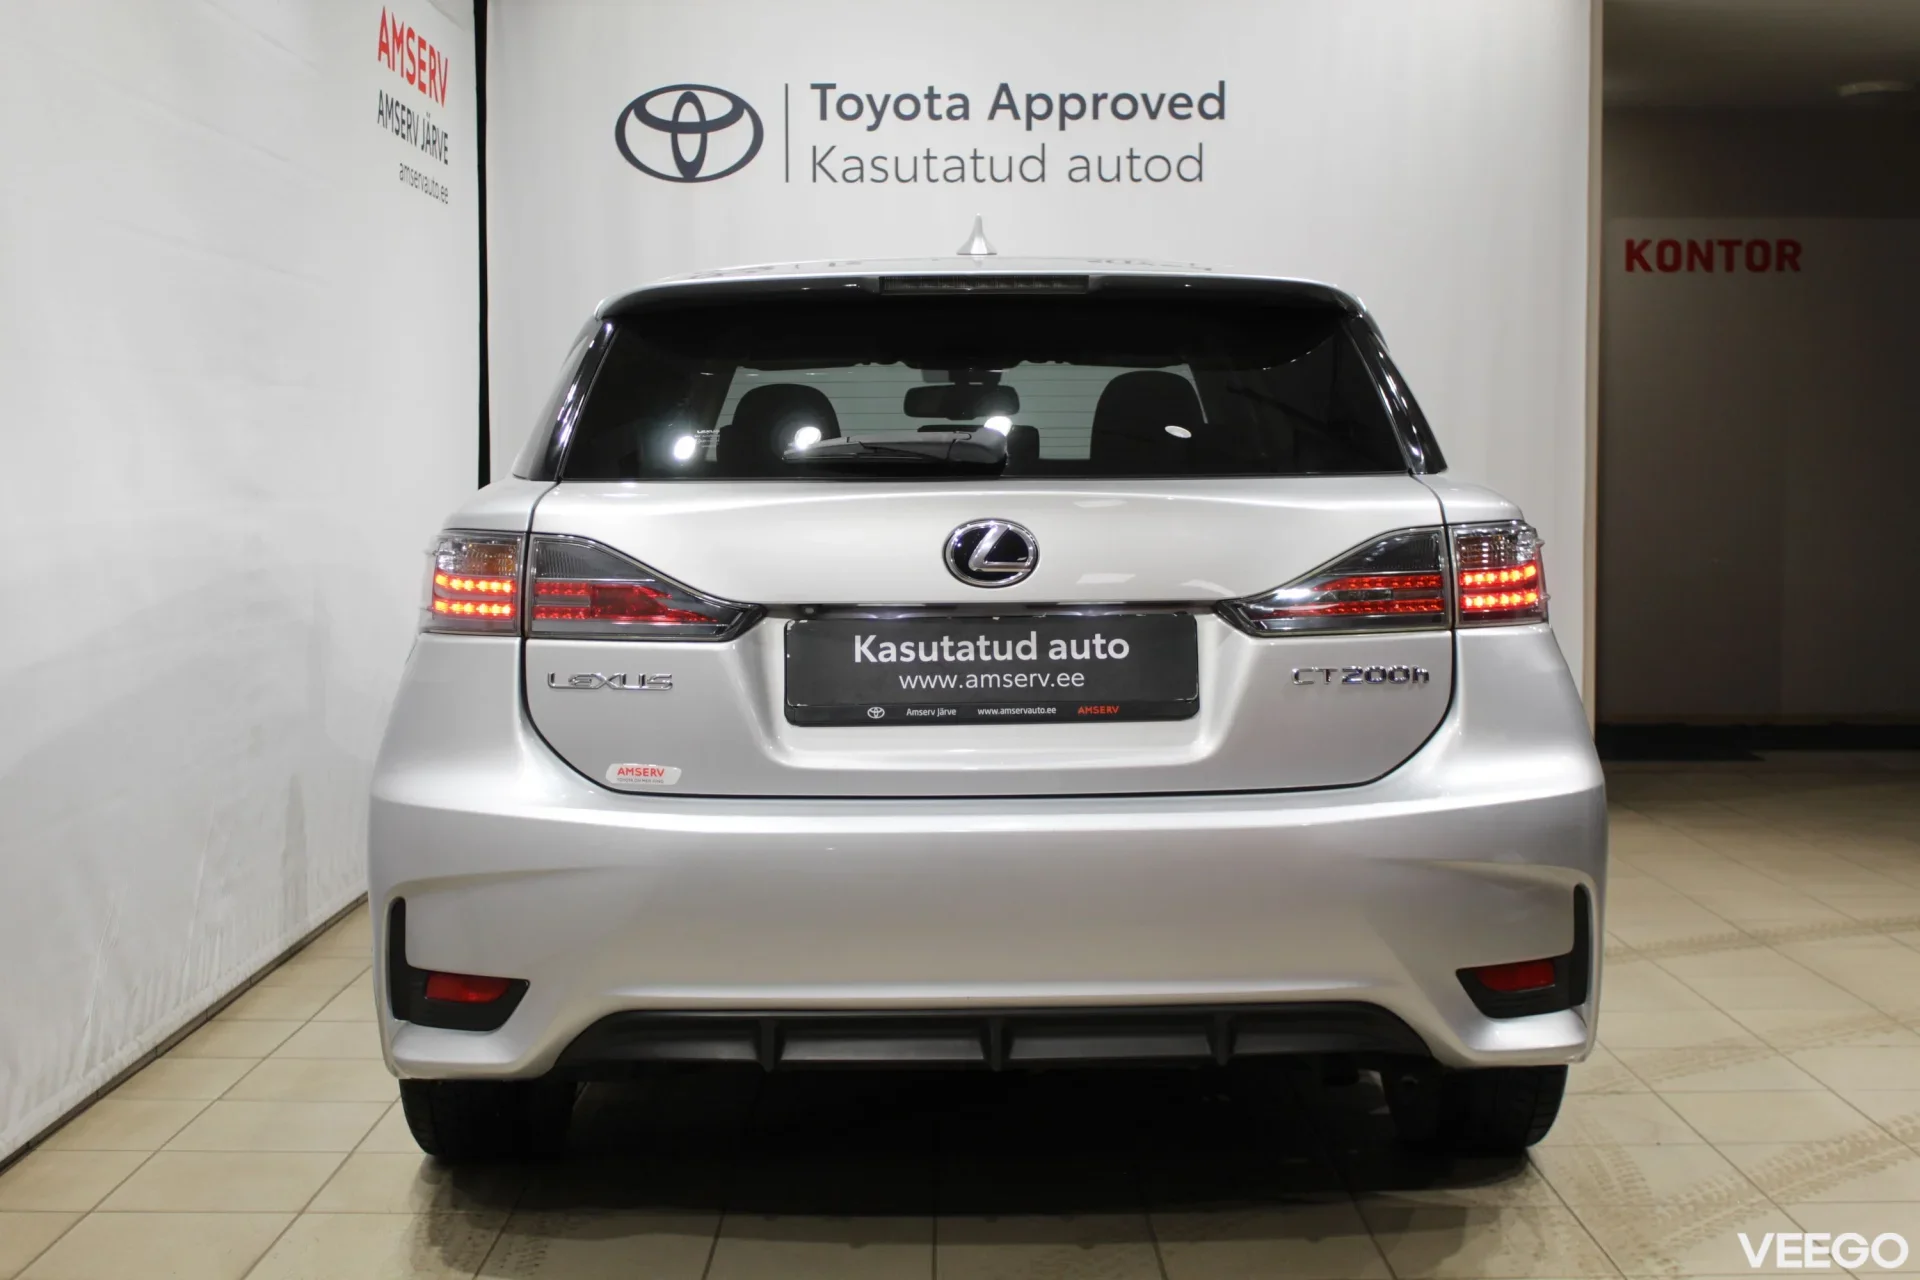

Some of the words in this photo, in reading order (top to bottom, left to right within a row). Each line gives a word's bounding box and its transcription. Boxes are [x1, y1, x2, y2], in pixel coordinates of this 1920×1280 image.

[377, 6, 449, 108] AMSERV
[809, 83, 971, 132] Toyota
[987, 80, 1226, 132] Approved
[377, 89, 420, 148] AMSERV
[420, 111, 449, 166] JÄRVE
[811, 142, 1047, 184] Kasutatud
[1067, 142, 1205, 184] autod
[399, 163, 449, 205] amservauto.ee
[1624, 238, 1803, 273] KONTOR
[854, 631, 1038, 663] Kasutatud
[1048, 633, 1130, 661] auto
[547, 671, 674, 692] LEXUS
[899, 671, 1086, 690] www.amserv.ee
[1291, 664, 1430, 686] CT200h
[906, 707, 935, 717] Amserv
[937, 706, 957, 718] Järve
[977, 705, 1057, 716] www.amservauto.ee
[1078, 705, 1120, 715] AMSERV
[617, 767, 665, 777] AMSERV
